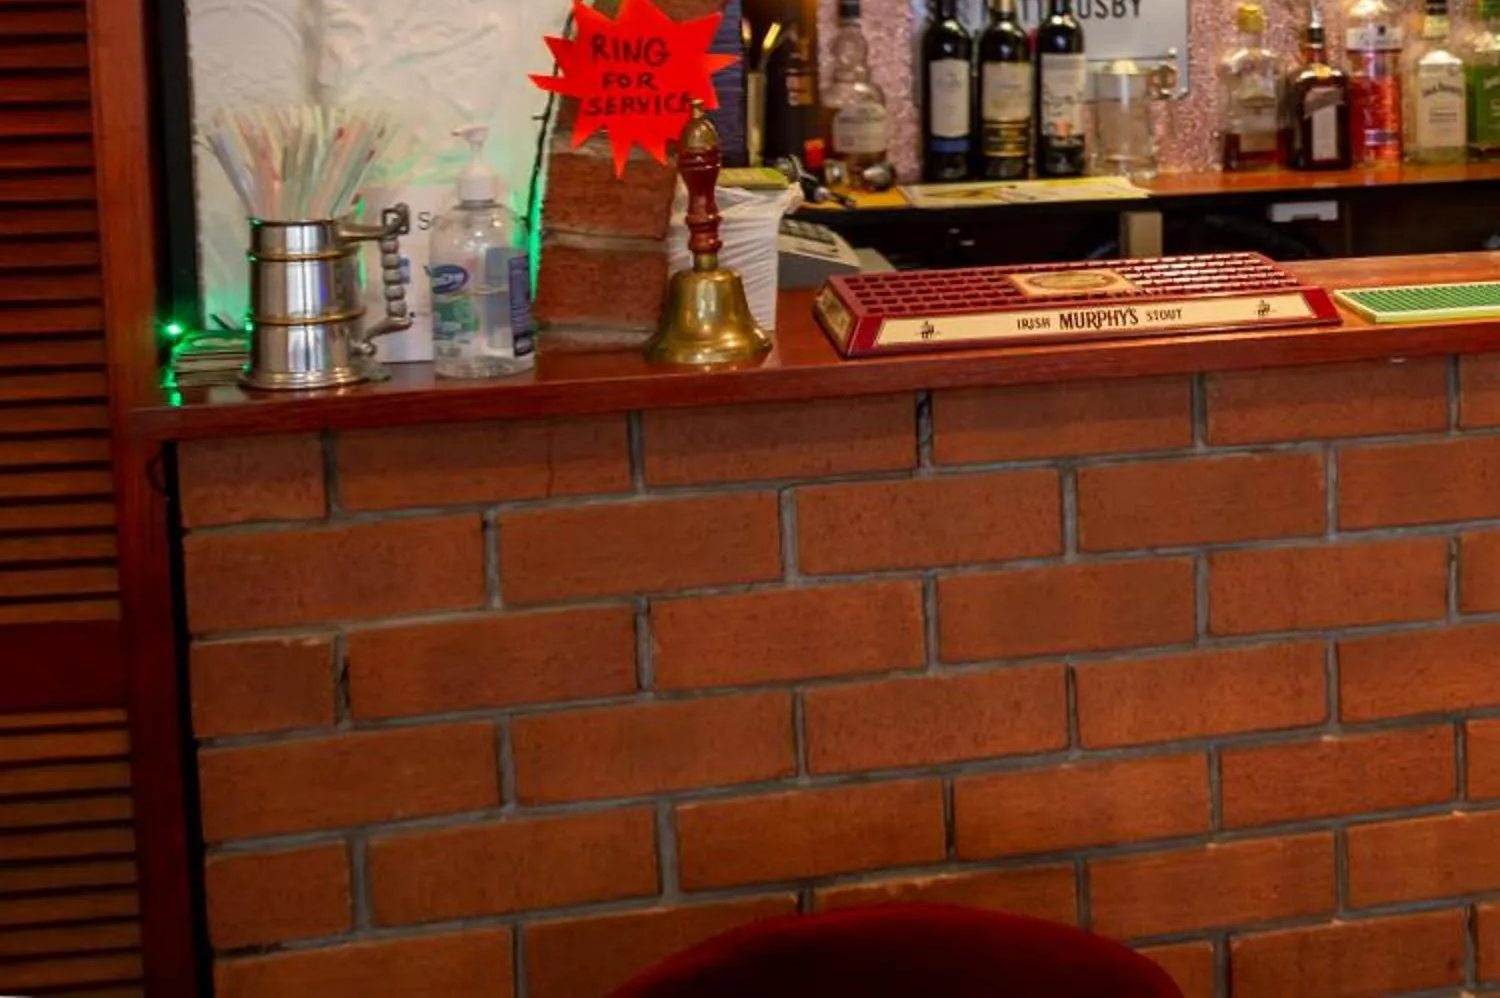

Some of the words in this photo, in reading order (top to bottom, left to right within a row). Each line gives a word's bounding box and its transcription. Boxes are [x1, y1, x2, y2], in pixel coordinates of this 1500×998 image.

[590, 32, 671, 68] RING
[602, 72, 659, 91] FOR
[585, 91, 691, 117] SERVICE
[1016, 317, 1051, 331] IRISH
[1059, 307, 1139, 330] MURPHY'S
[1146, 309, 1182, 323] STOUT
